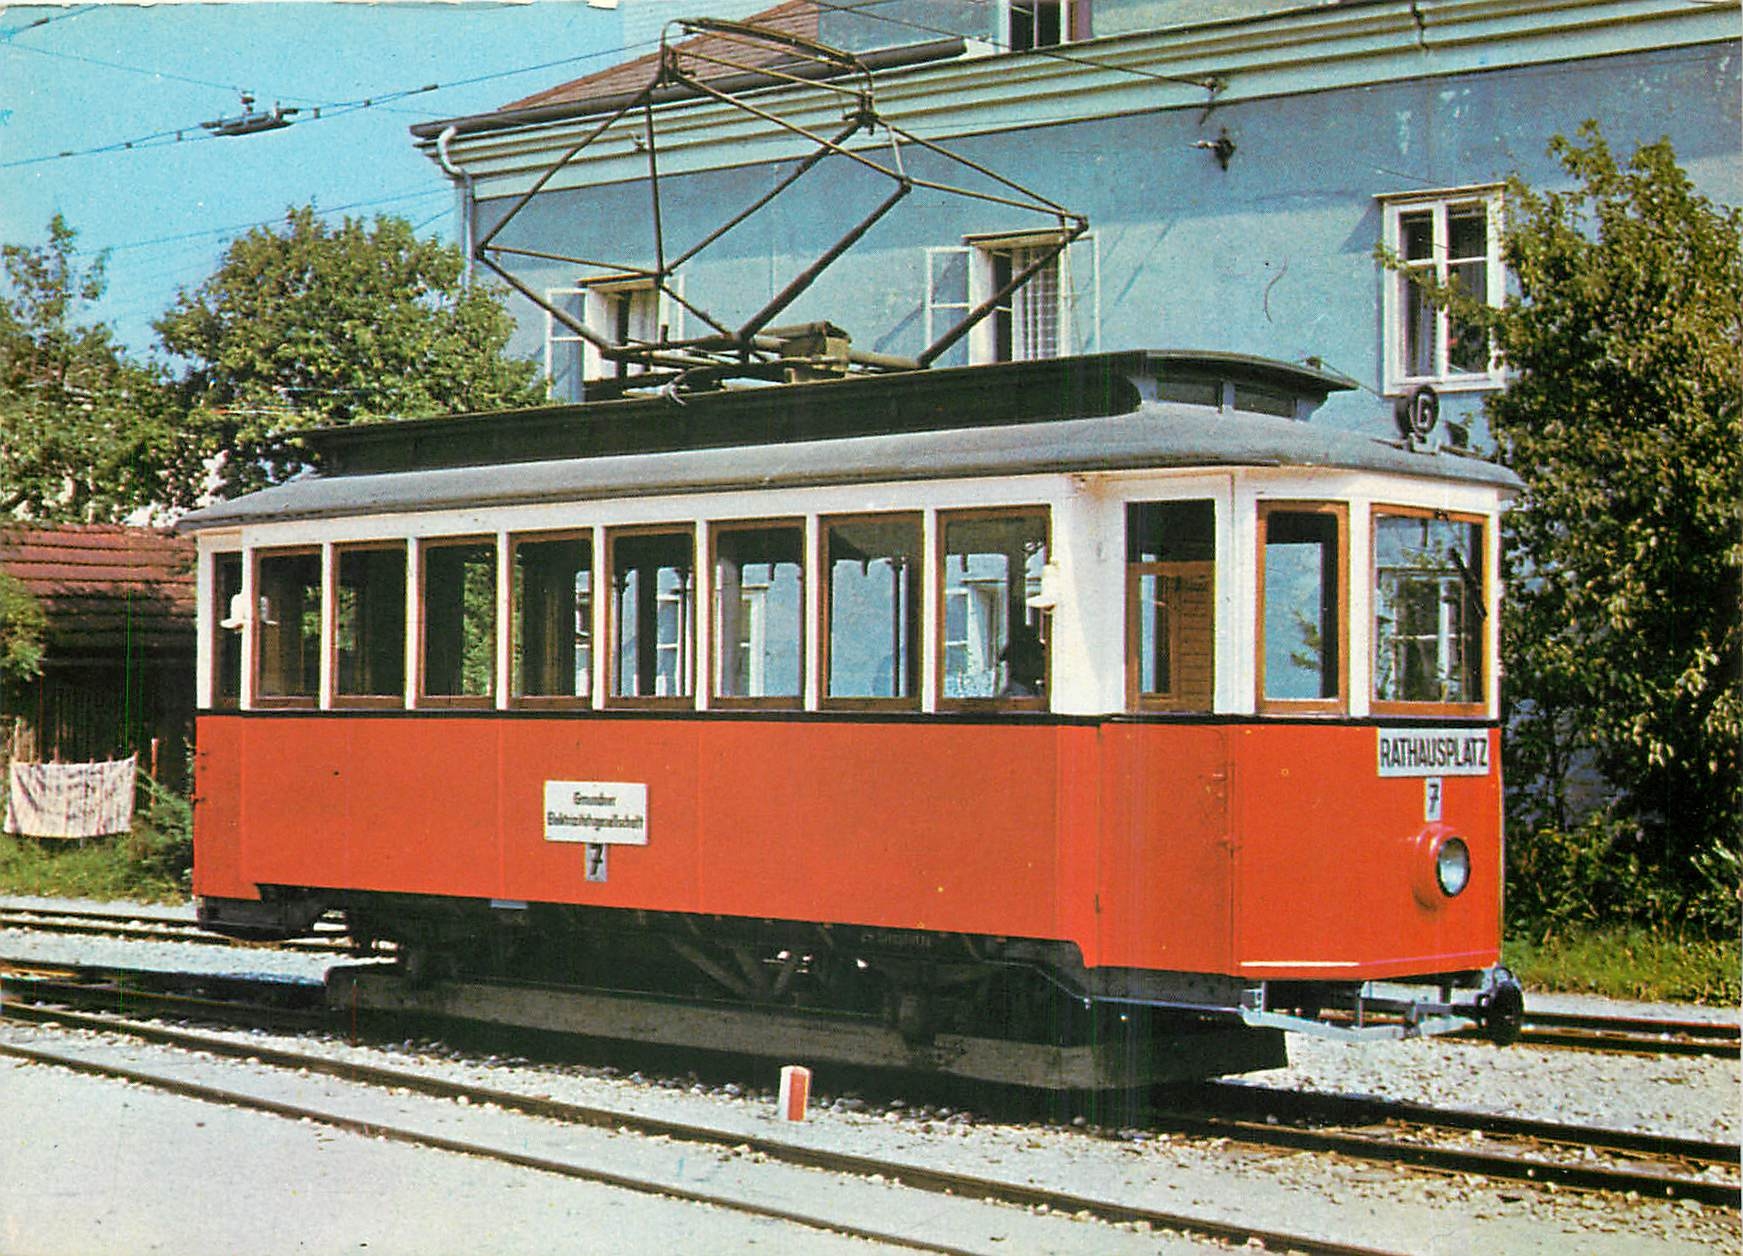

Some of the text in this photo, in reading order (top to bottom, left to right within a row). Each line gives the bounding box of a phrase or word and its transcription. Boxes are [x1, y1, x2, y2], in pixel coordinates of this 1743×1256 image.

[1380, 737, 1488, 767] RATHAUSPLATZ
[1428, 783, 1440, 813] 7
[589, 843, 604, 876] 7
